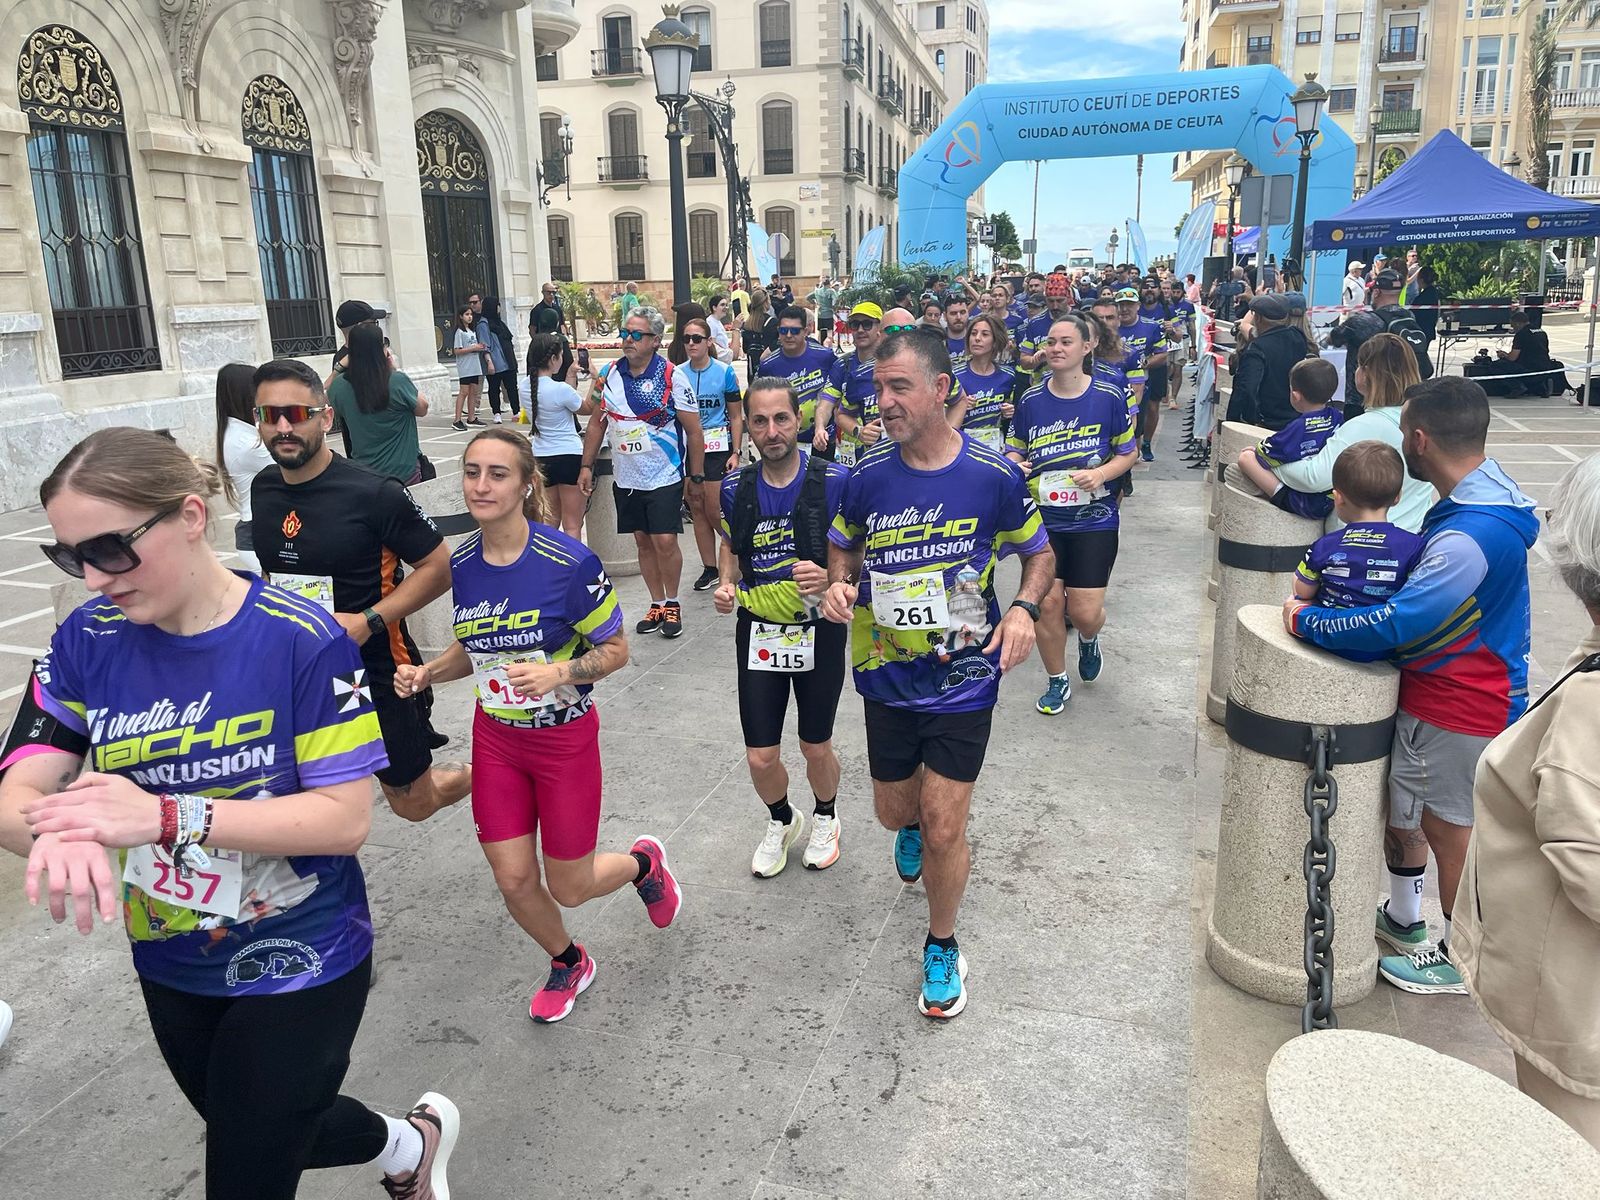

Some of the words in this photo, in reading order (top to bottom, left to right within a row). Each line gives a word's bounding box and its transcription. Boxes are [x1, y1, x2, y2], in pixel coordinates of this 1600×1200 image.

[1004, 98, 1080, 116] INSTITUTO
[1083, 91, 1128, 112] CEUTÍ
[1131, 92, 1152, 108] DE
[1156, 85, 1241, 106] DEPORTES
[1018, 126, 1069, 139] CIUDAD
[1071, 121, 1151, 136] AUTÓNOMA
[1154, 118, 1173, 131] DE
[1177, 115, 1224, 129] CEUTA
[1401, 215, 1458, 226] CRONOMETRAJE
[1458, 212, 1514, 222] ORGANIZACIÓN
[1396, 233, 1427, 241] GESTIÓN
[1438, 230, 1470, 239] EVENTOS
[1471, 227, 1516, 237] DEPORTIVOS
[627, 441, 642, 453] 70
[708, 440, 721, 451] 69
[1041, 437, 1101, 457] INCLUSIÓN
[840, 454, 854, 467] 126
[1060, 491, 1079, 504] 94
[876, 506, 921, 531] vuelta
[922, 503, 944, 523] al
[884, 538, 977, 565] INCLUSIÓN
[909, 578, 924, 588] 10K
[457, 600, 493, 623] vuelta
[492, 597, 509, 616] al
[893, 606, 937, 626] 261
[770, 652, 805, 669] 115
[500, 680, 543, 705] 19
[108, 698, 180, 740] vuelta
[180, 691, 213, 726] al
[131, 744, 275, 786] INCLUSIÓN
[153, 861, 222, 905] 257
